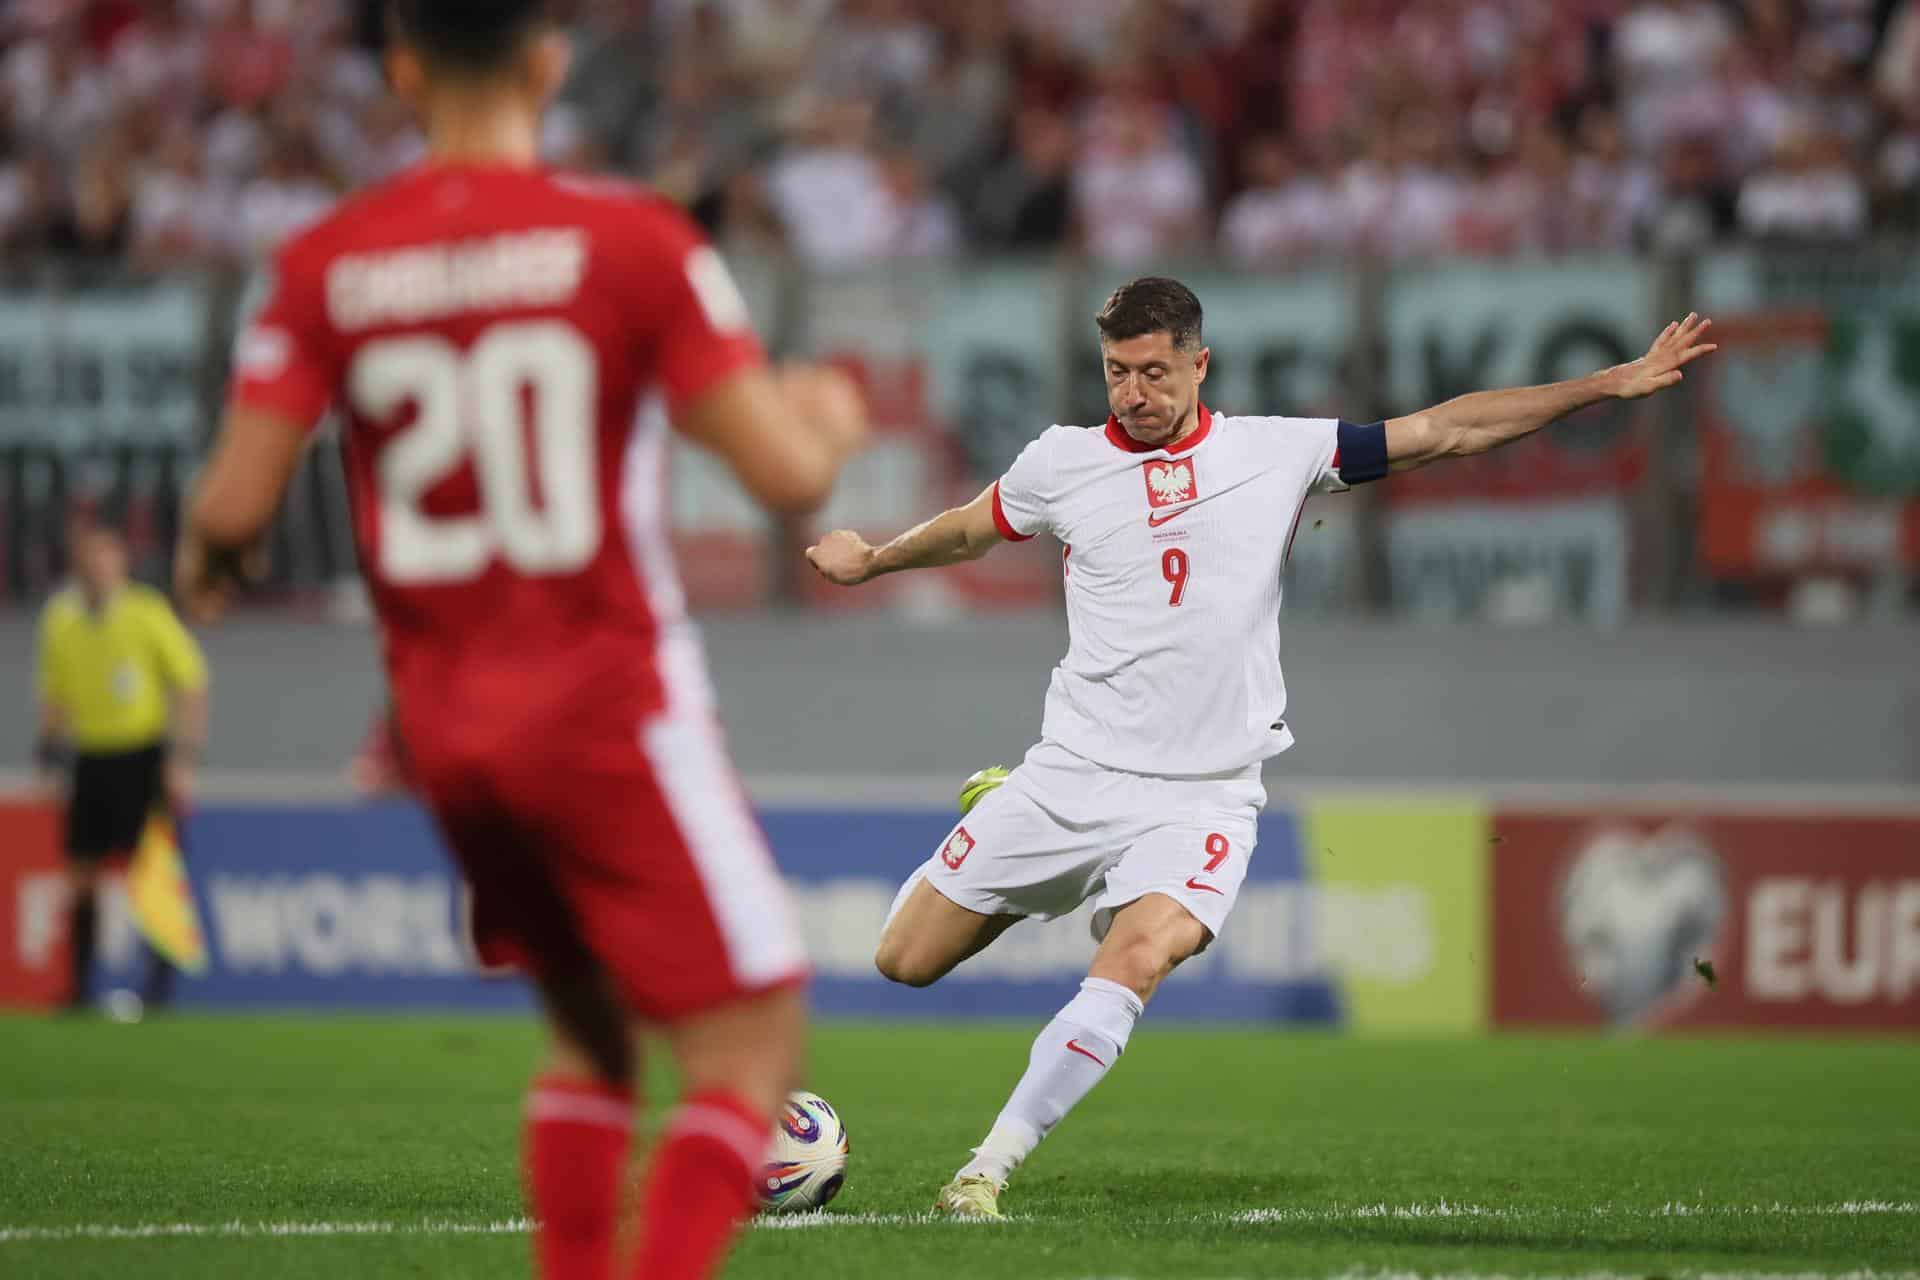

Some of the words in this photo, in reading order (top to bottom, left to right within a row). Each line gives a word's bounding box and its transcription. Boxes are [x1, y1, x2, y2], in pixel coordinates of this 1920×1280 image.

[348, 318, 602, 586] 20
[1162, 548, 1190, 606] 9
[1203, 833, 1230, 874] 9
[208, 870, 468, 976] WORL
